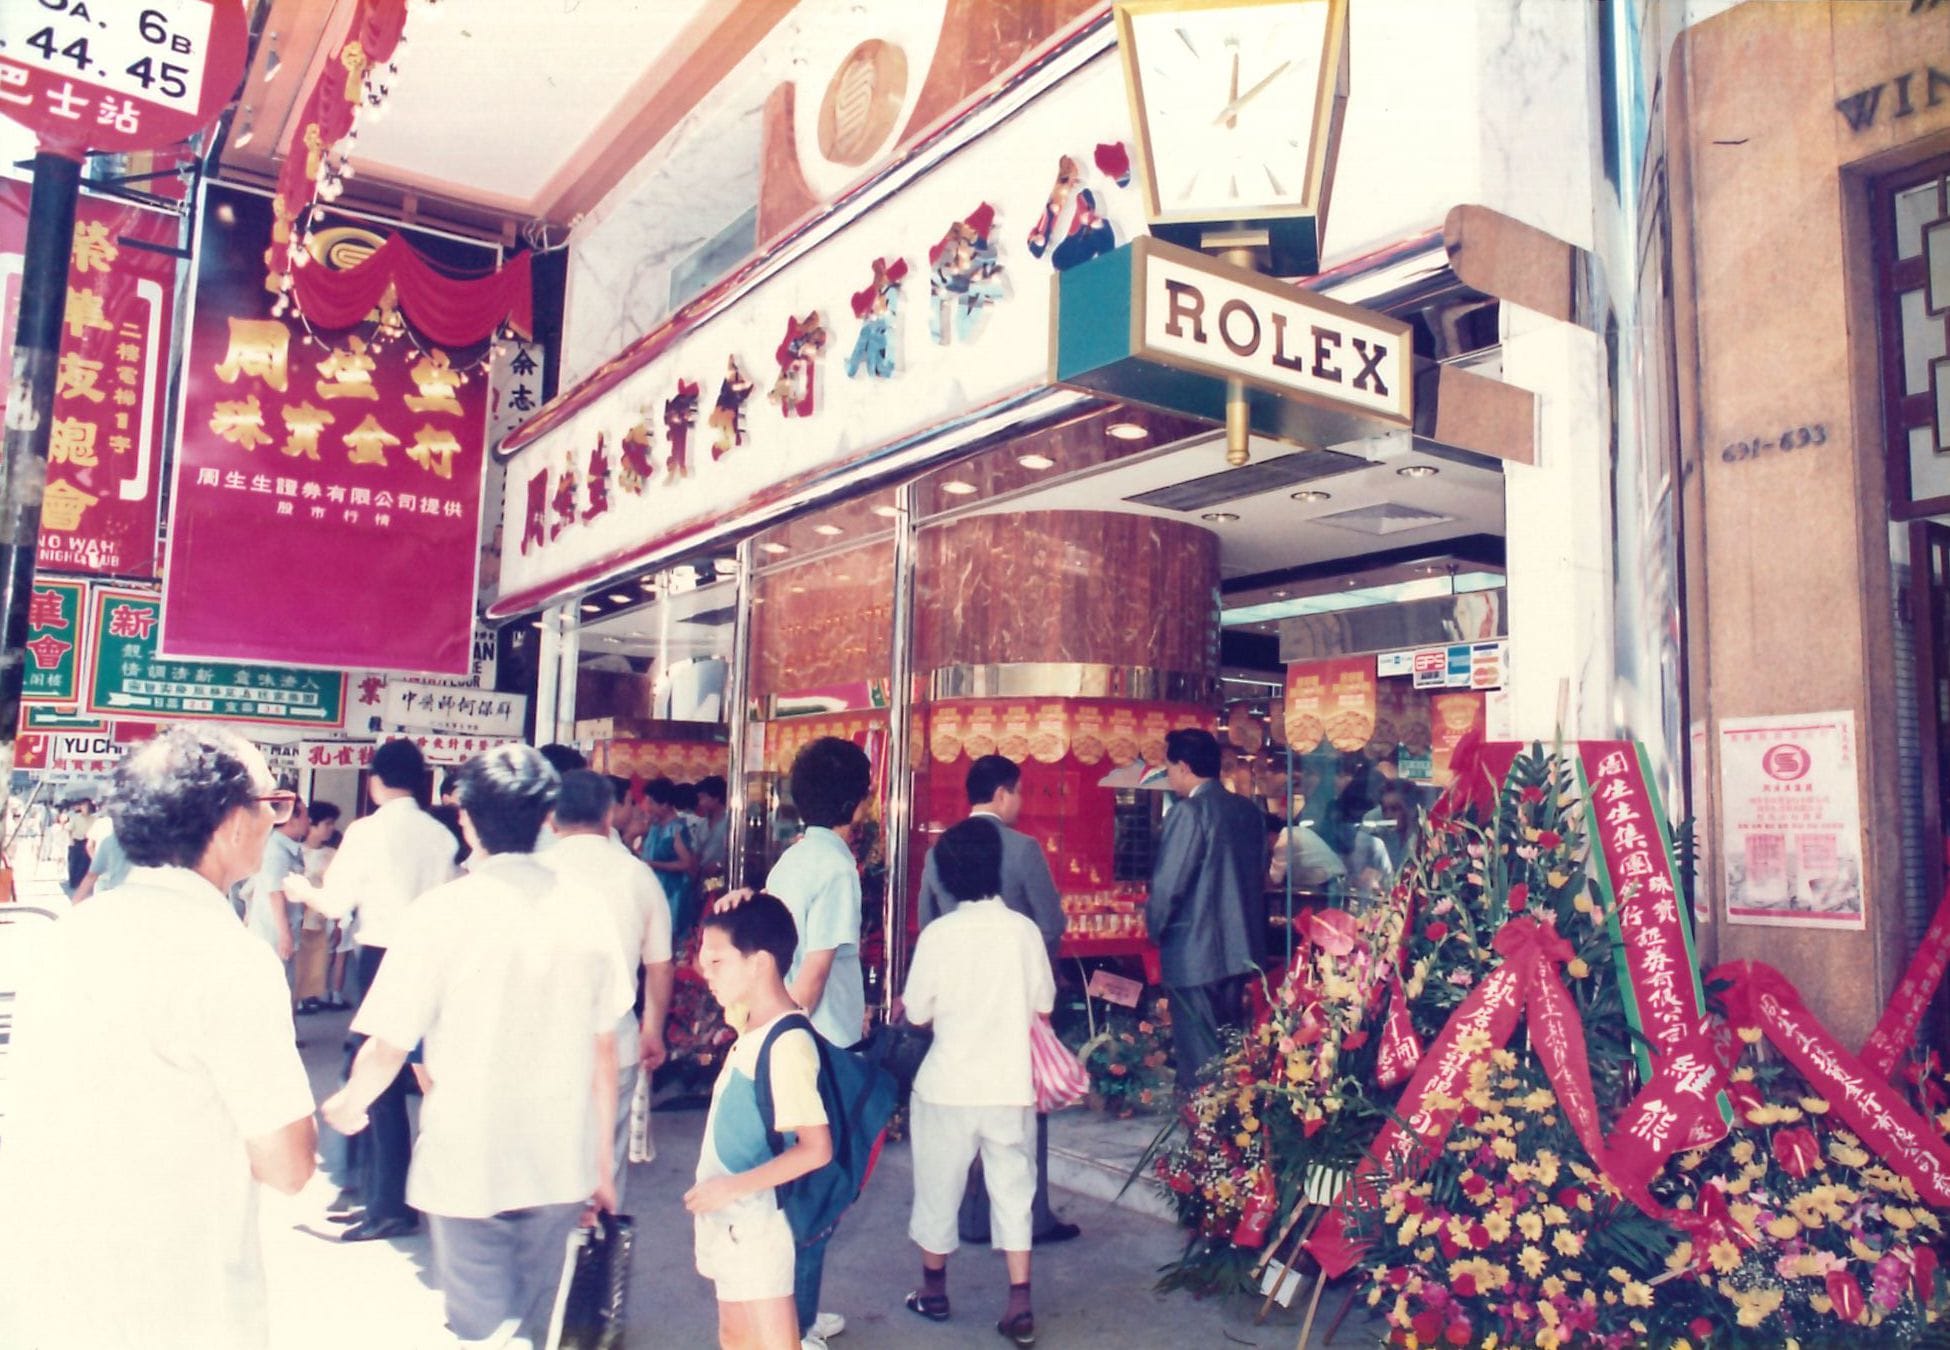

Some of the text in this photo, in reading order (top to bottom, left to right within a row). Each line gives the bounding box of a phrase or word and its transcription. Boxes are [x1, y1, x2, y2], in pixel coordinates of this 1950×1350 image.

[138, 9, 192, 54] 6B
[125, 56, 190, 98] 45
[0, 64, 141, 134] 巴士站
[1165, 279, 1389, 397] ROLEX
[508, 347, 538, 432] 余志
[109, 604, 157, 640] 新
[1415, 653, 1446, 671] EPS
[65, 738, 89, 754] YU
